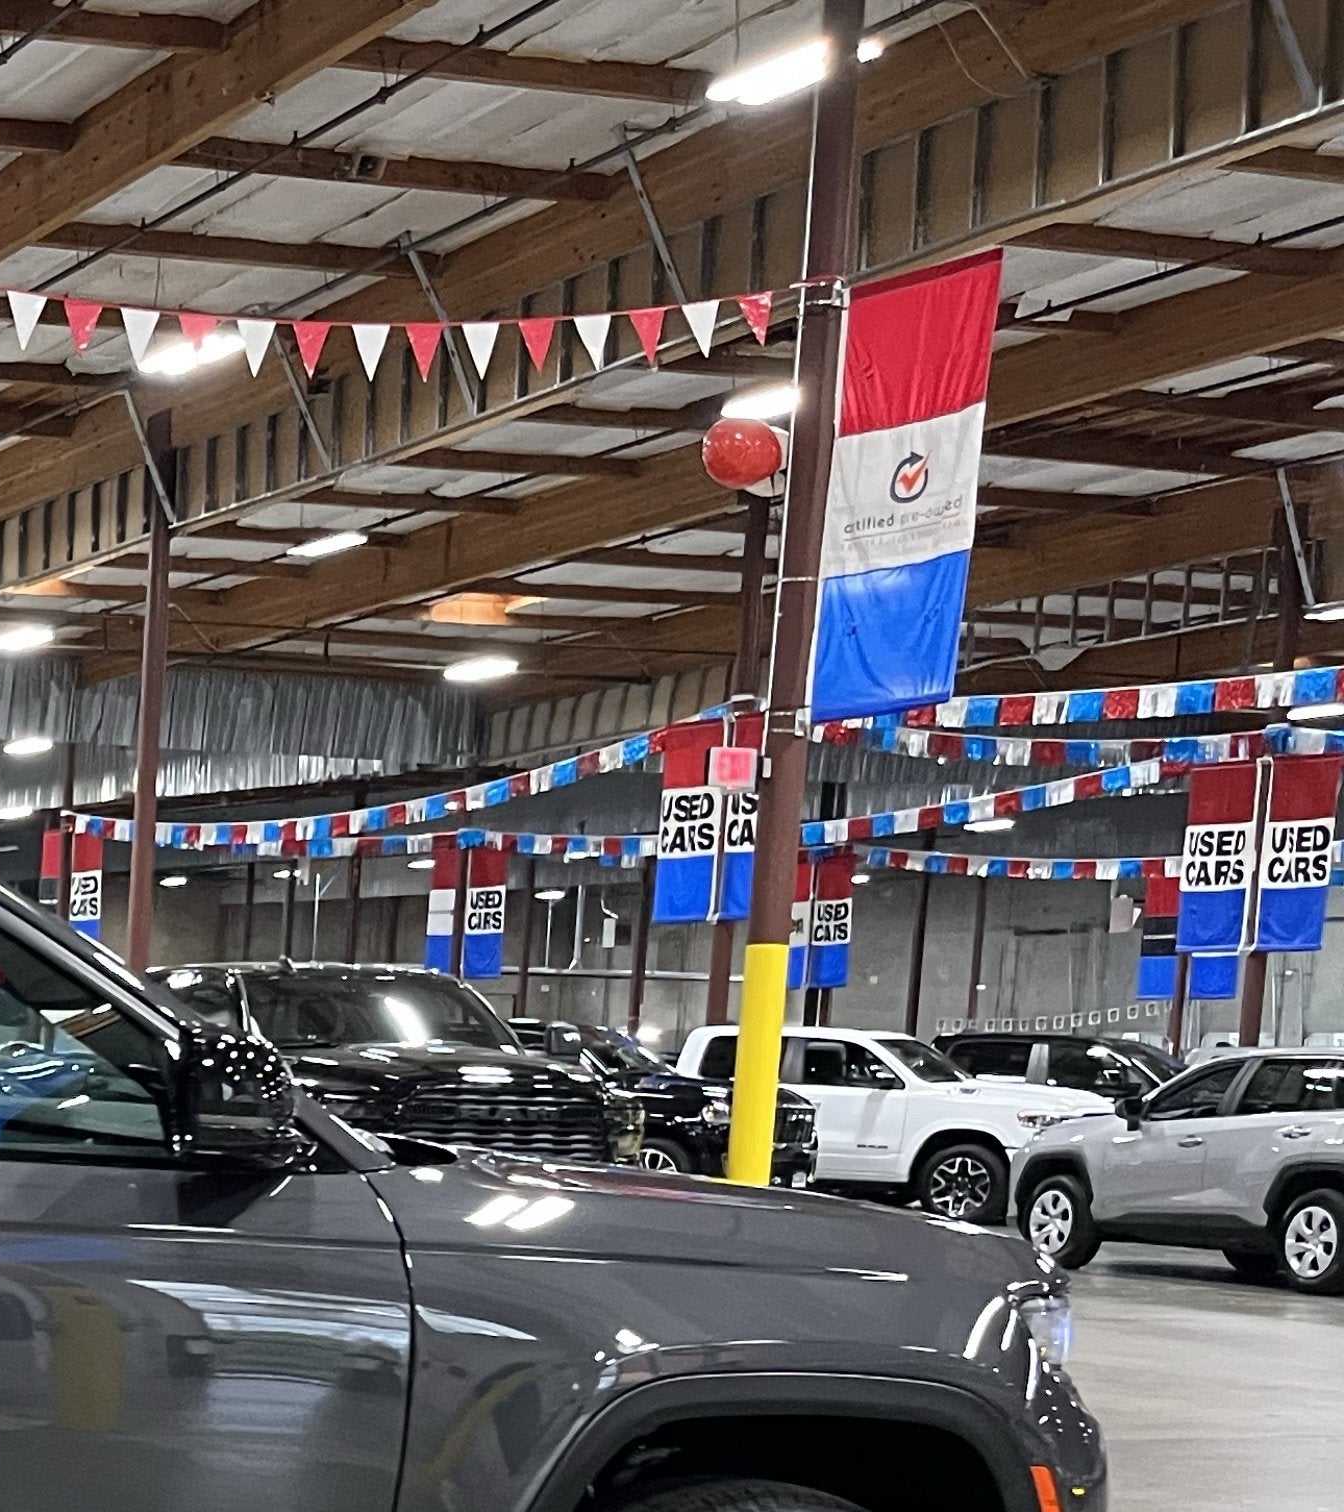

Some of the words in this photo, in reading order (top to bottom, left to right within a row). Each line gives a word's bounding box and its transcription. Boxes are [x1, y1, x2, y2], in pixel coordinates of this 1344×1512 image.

[900, 494, 964, 527] pre-owed
[661, 793, 715, 823] USED
[661, 823, 715, 853] CARS
[1189, 830, 1246, 857] USED
[1271, 825, 1331, 854] USED
[1185, 859, 1244, 886] CARS
[1267, 854, 1329, 883] CARS
[470, 890, 503, 910] USED
[817, 903, 849, 922] USED
